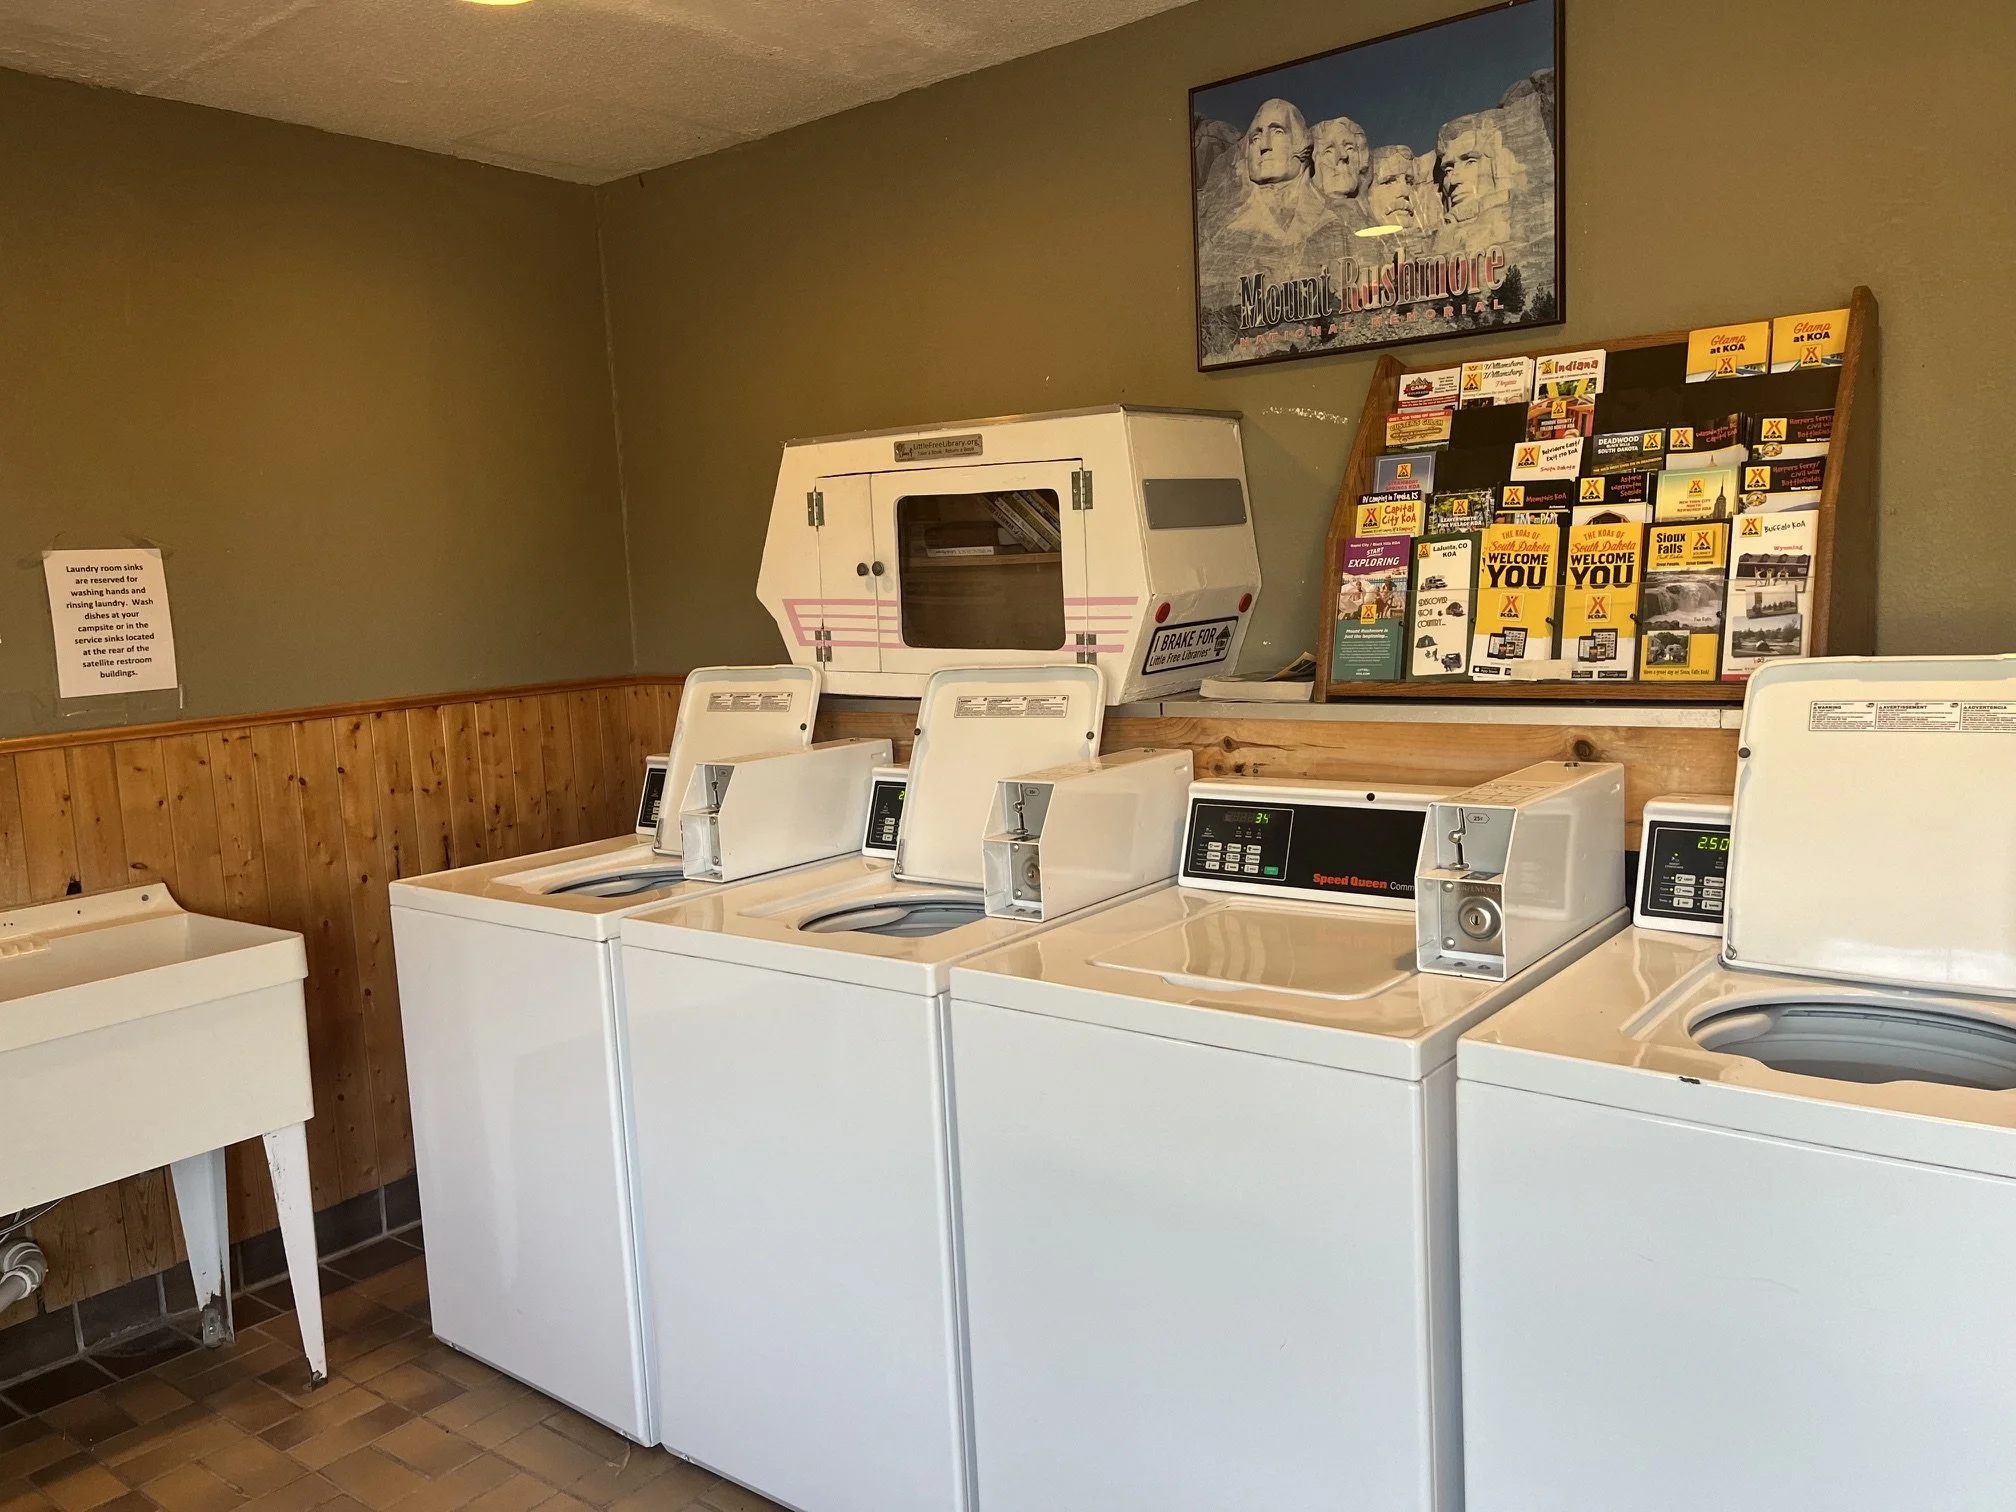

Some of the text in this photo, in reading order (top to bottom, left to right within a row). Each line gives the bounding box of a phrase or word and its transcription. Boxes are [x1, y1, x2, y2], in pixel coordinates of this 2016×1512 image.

[1238, 244, 1505, 330] Mount Rushmore
[1240, 299, 1505, 346] NATIONAL MEMORIAL
[1793, 322, 1831, 334] Glamp
[1710, 334, 1746, 346] Glamp
[1793, 331, 1830, 343] at KOA
[1710, 343, 1745, 354] at KOA
[1554, 360, 1599, 374] Indiana
[1789, 414, 1832, 425] Harpers Ferry
[1806, 422, 1822, 430] Civil
[913, 440, 981, 450] LittleFreeLibrary.org
[1598, 436, 1640, 446] DEADWOOD
[1542, 445, 1565, 456] Belvidere
[1568, 448, 1578, 456] KOA
[1772, 465, 1798, 473] Harpers
[1790, 470, 1806, 478] Civil
[1620, 474, 1642, 483] Astoria
[1781, 476, 1821, 486] Battlefields
[1620, 489, 1642, 497] Seaside
[1369, 494, 1387, 504] Camping
[1384, 502, 1414, 515] Capital
[1382, 512, 1416, 526] City KOA
[1764, 520, 1806, 534] Buffalo KOA
[1502, 529, 1540, 540] THE KOAs OF
[1583, 530, 1626, 541] THE KOAs OF
[1656, 532, 1686, 543] Sioux
[1366, 546, 1384, 556] START
[1488, 540, 1551, 552] South Dakota
[1570, 540, 1637, 554] South Dakota
[1658, 544, 1683, 554] Falls
[1348, 556, 1400, 568] EXPLORING
[1488, 552, 1549, 565] WELCOME
[1570, 552, 1635, 566] WELCOME
[66, 565, 99, 574] Laundry
[100, 564, 122, 572] room
[90, 576, 125, 584] reserved
[1486, 564, 1548, 590] YOU
[1569, 565, 1634, 590] YOU
[70, 588, 104, 597] washing
[106, 588, 130, 596] hands
[66, 598, 154, 610] rinsing laundry. Wash
[1418, 596, 1448, 607] DISCOVER
[84, 612, 110, 620] dishes
[121, 612, 140, 620] your
[78, 624, 114, 633] campsite
[74, 633, 155, 645] service sinks located
[1153, 627, 1217, 653] I BRAKE FOR
[126, 645, 135, 653] of
[82, 657, 153, 668] satellite restroom
[1148, 652, 1181, 667] Little Free
[100, 668, 138, 678] buildings.
[1255, 812, 1269, 824] 34
[1697, 836, 1730, 851] 2.50
[1312, 873, 1388, 890] Speed Queen
